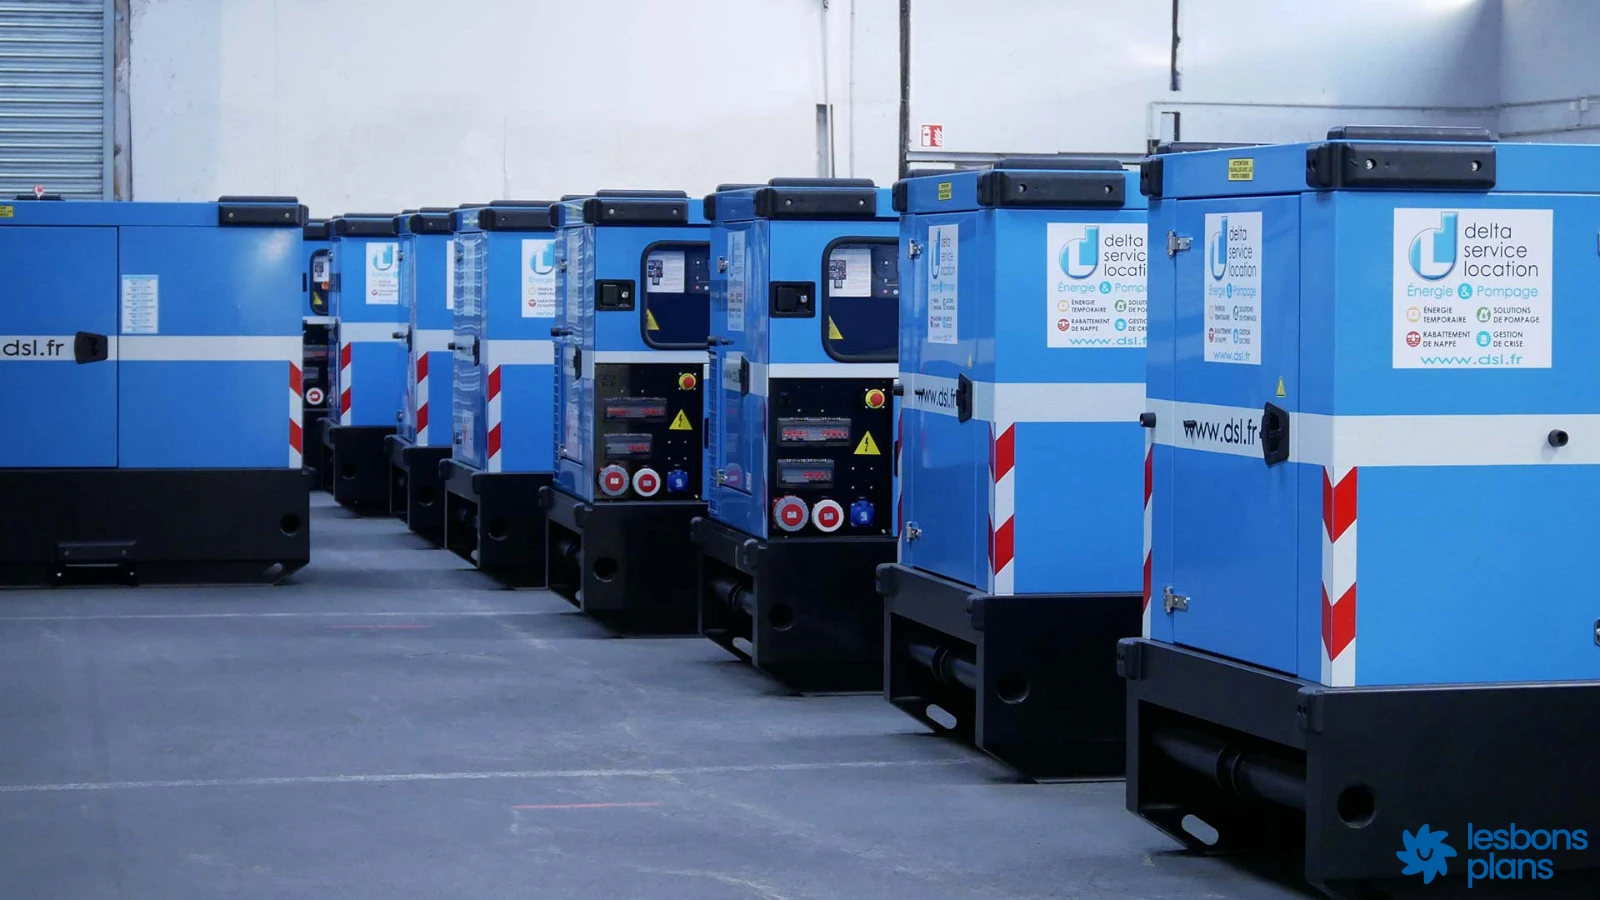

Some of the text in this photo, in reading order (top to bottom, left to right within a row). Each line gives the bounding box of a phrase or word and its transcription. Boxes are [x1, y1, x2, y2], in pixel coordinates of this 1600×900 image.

[1229, 226, 1247, 241] delta
[1464, 223, 1512, 239] delta
[1104, 234, 1143, 247] delta
[1104, 249, 1146, 262] servic
[1229, 244, 1252, 259] service
[1464, 242, 1528, 258] service
[1104, 264, 1146, 276] locati
[1229, 262, 1256, 277] location
[1464, 261, 1538, 277] location
[1115, 283, 1147, 294] Pomp
[1408, 283, 1453, 299] Énergie
[1477, 285, 1538, 299] Pompage
[1423, 305, 1452, 314] ÉNERGIE
[1070, 336, 1147, 345] www.dsl.f
[1421, 354, 1524, 366] www.dsl.fr
[1183, 418, 1257, 445] www.dsl.fr
